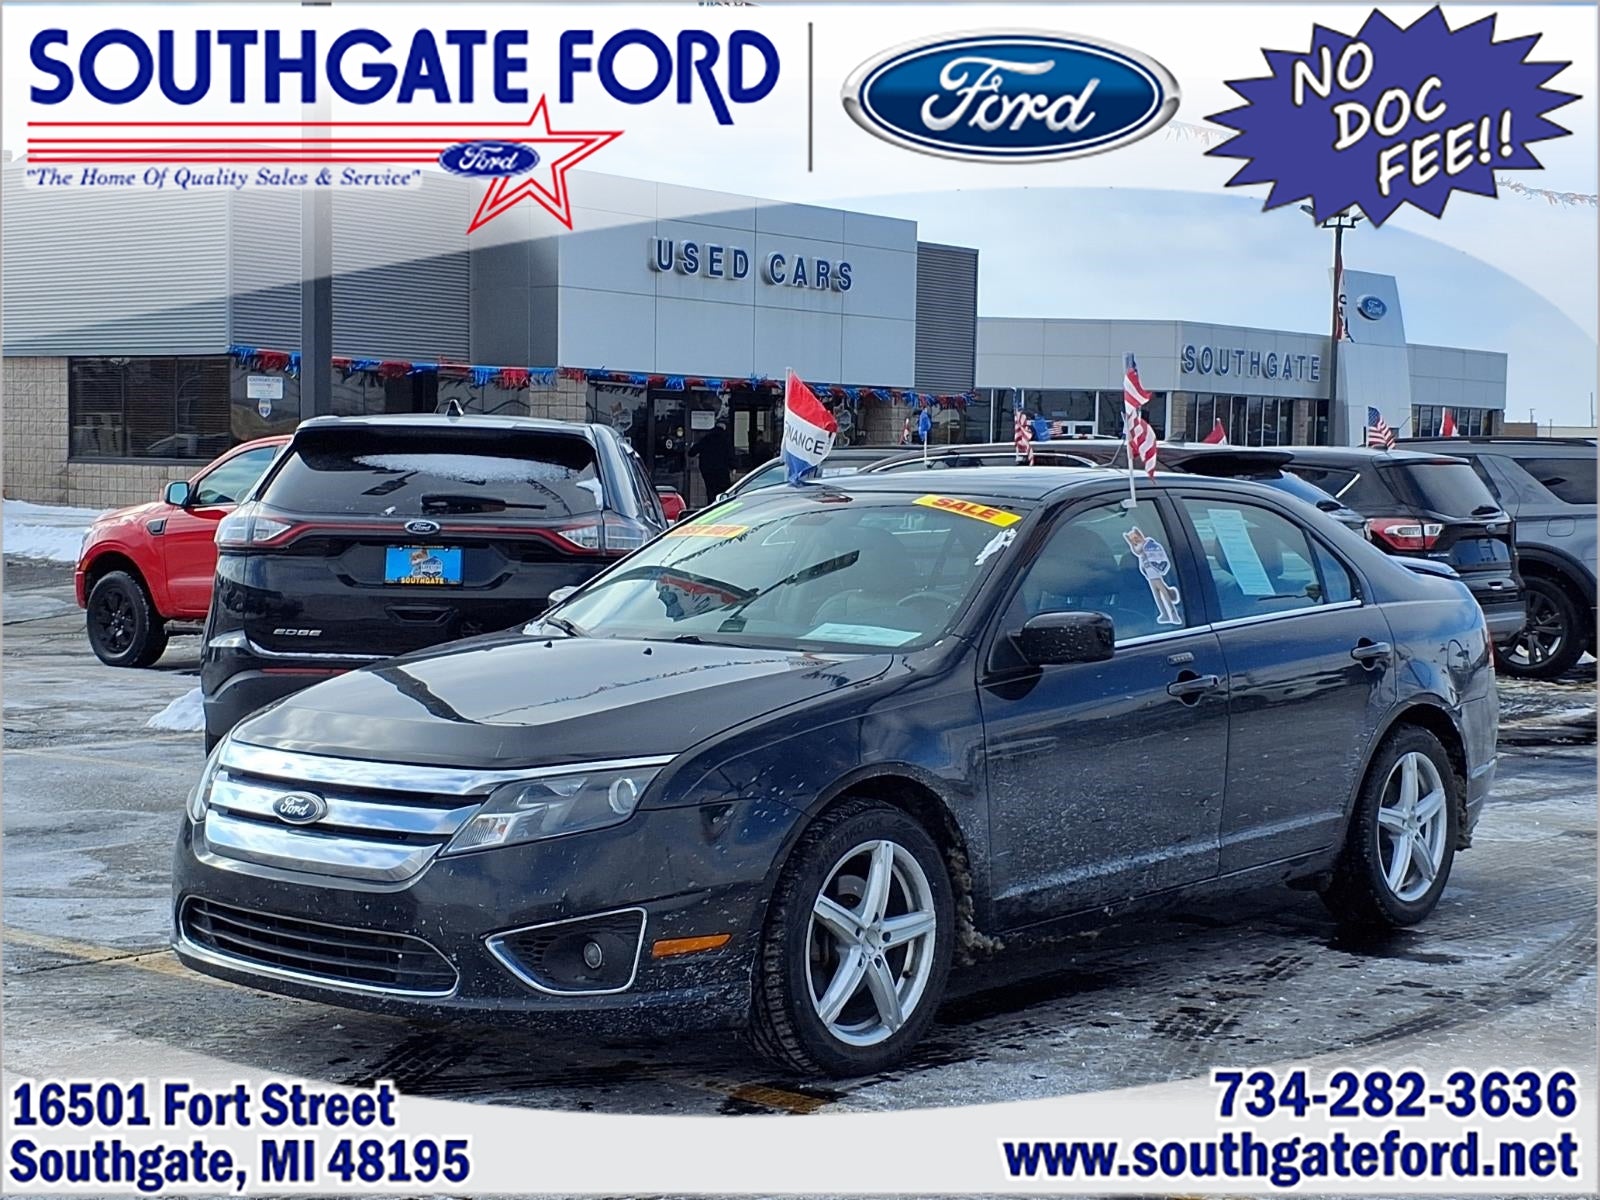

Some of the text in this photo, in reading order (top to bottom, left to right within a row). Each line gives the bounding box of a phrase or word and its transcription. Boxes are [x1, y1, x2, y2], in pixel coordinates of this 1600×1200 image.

[653, 238, 852, 292] USED CARS
[1182, 345, 1320, 381] SOUTHGATE
[932, 498, 1001, 519] SALE
[400, 576, 444, 585] SOUTHGATE
[273, 628, 322, 637] EDGE
[280, 796, 309, 816] Ford
